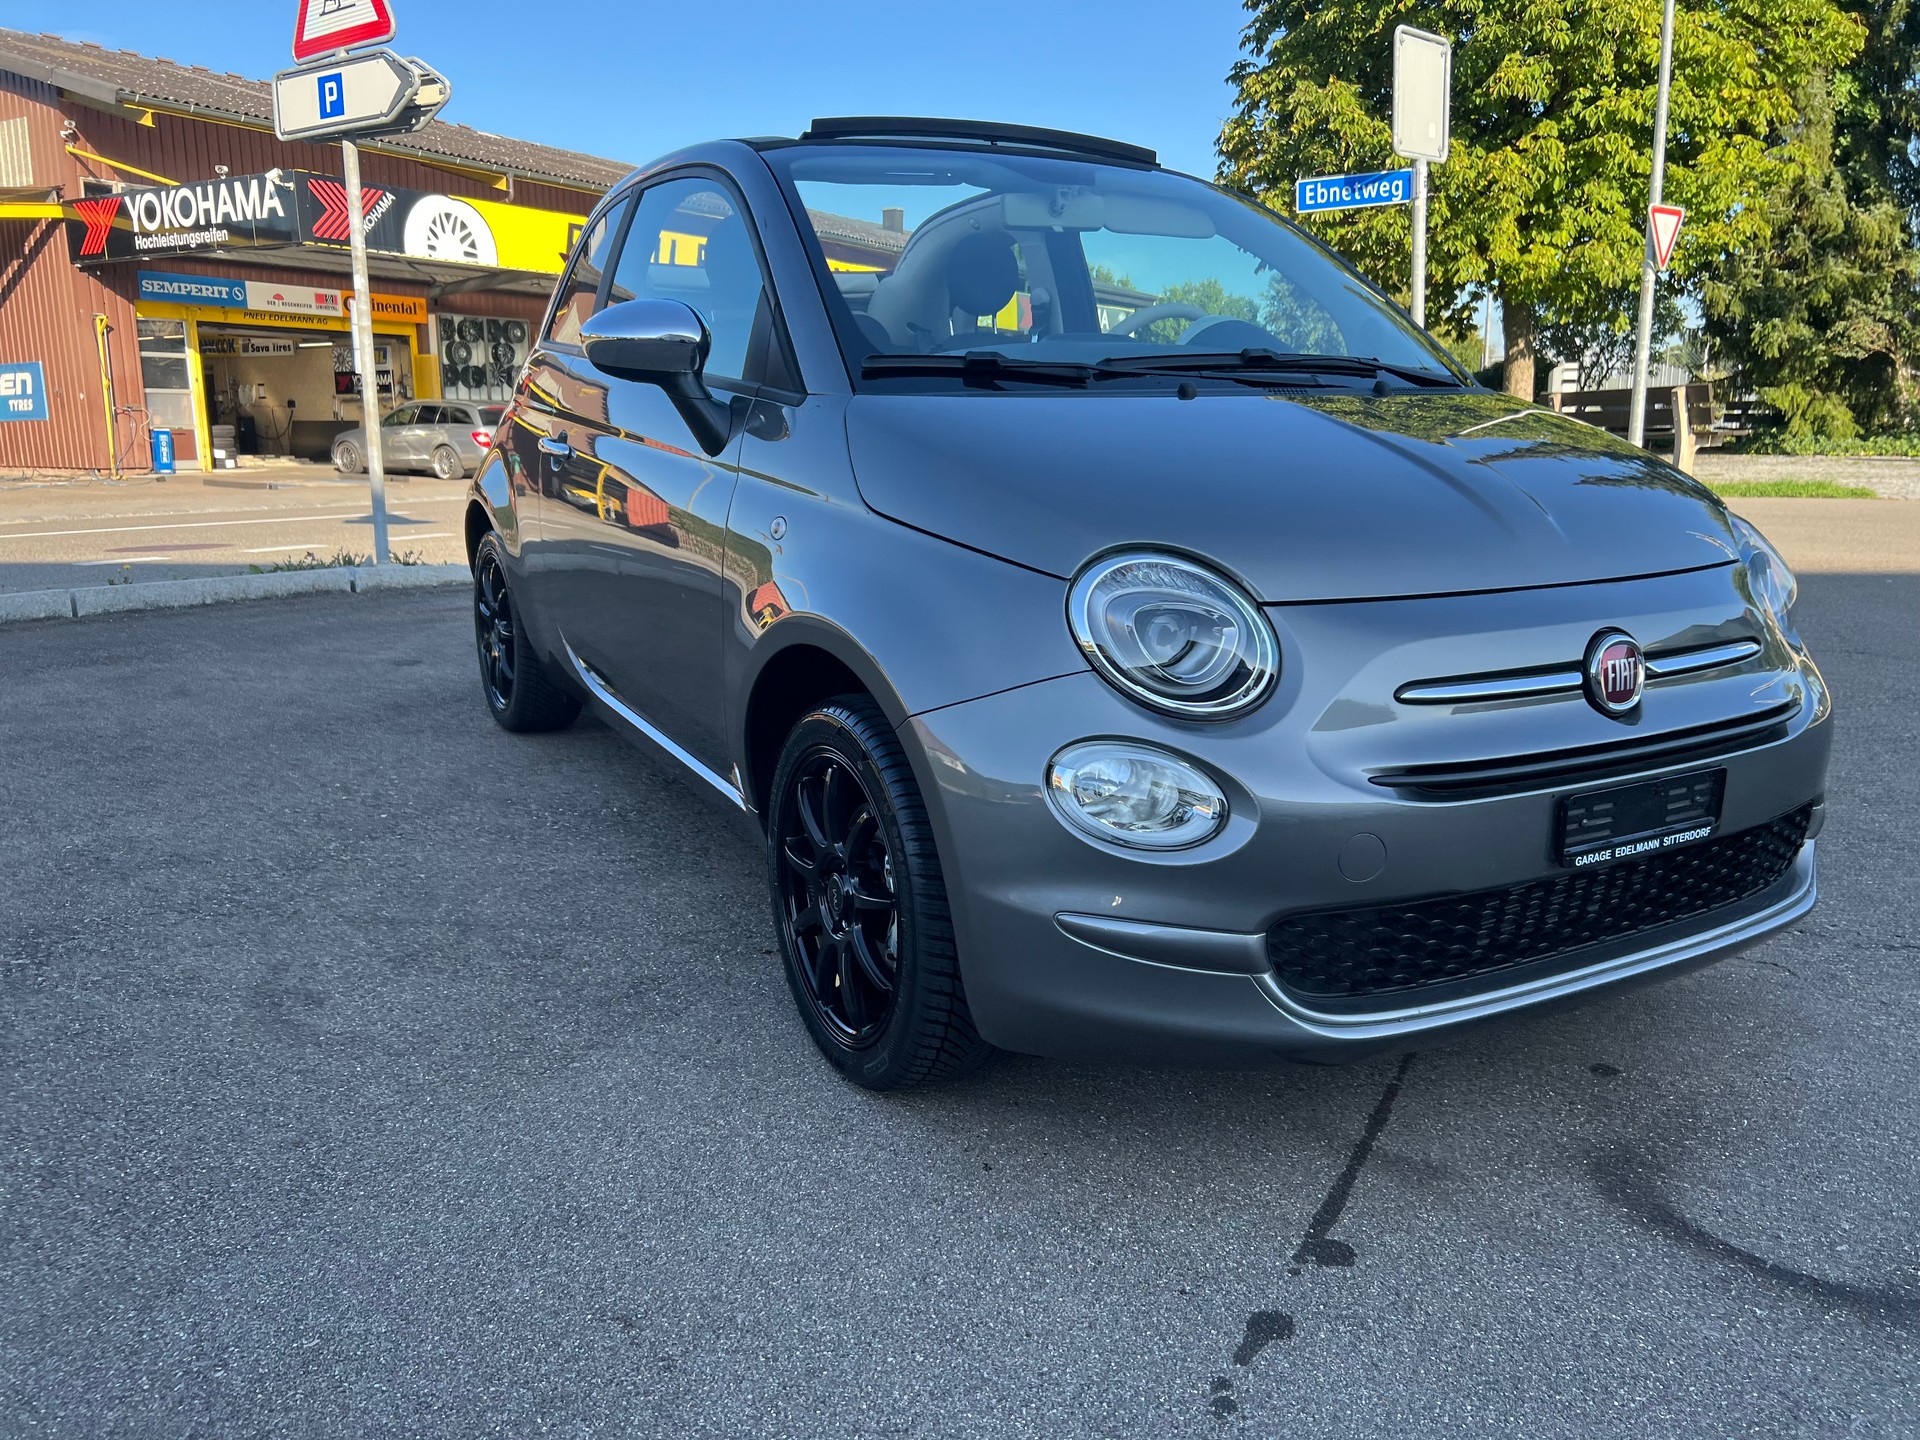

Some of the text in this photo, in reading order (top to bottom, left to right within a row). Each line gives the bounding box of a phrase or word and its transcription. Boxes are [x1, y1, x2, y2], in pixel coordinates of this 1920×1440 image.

[1305, 179, 1403, 202] Ebnetweg
[124, 179, 285, 233] YOKOHAMA
[135, 227, 229, 250] Hochleistungsreifen
[142, 279, 229, 299] SEMPERIT
[243, 311, 328, 325] PNEU EDELMANN AG
[250, 342, 291, 352] Sava Tires
[9, 399, 33, 411] TYRES
[1607, 657, 1636, 693] FIAT
[1575, 827, 1712, 867] GARAGE EDELMANN SITTERDORF
